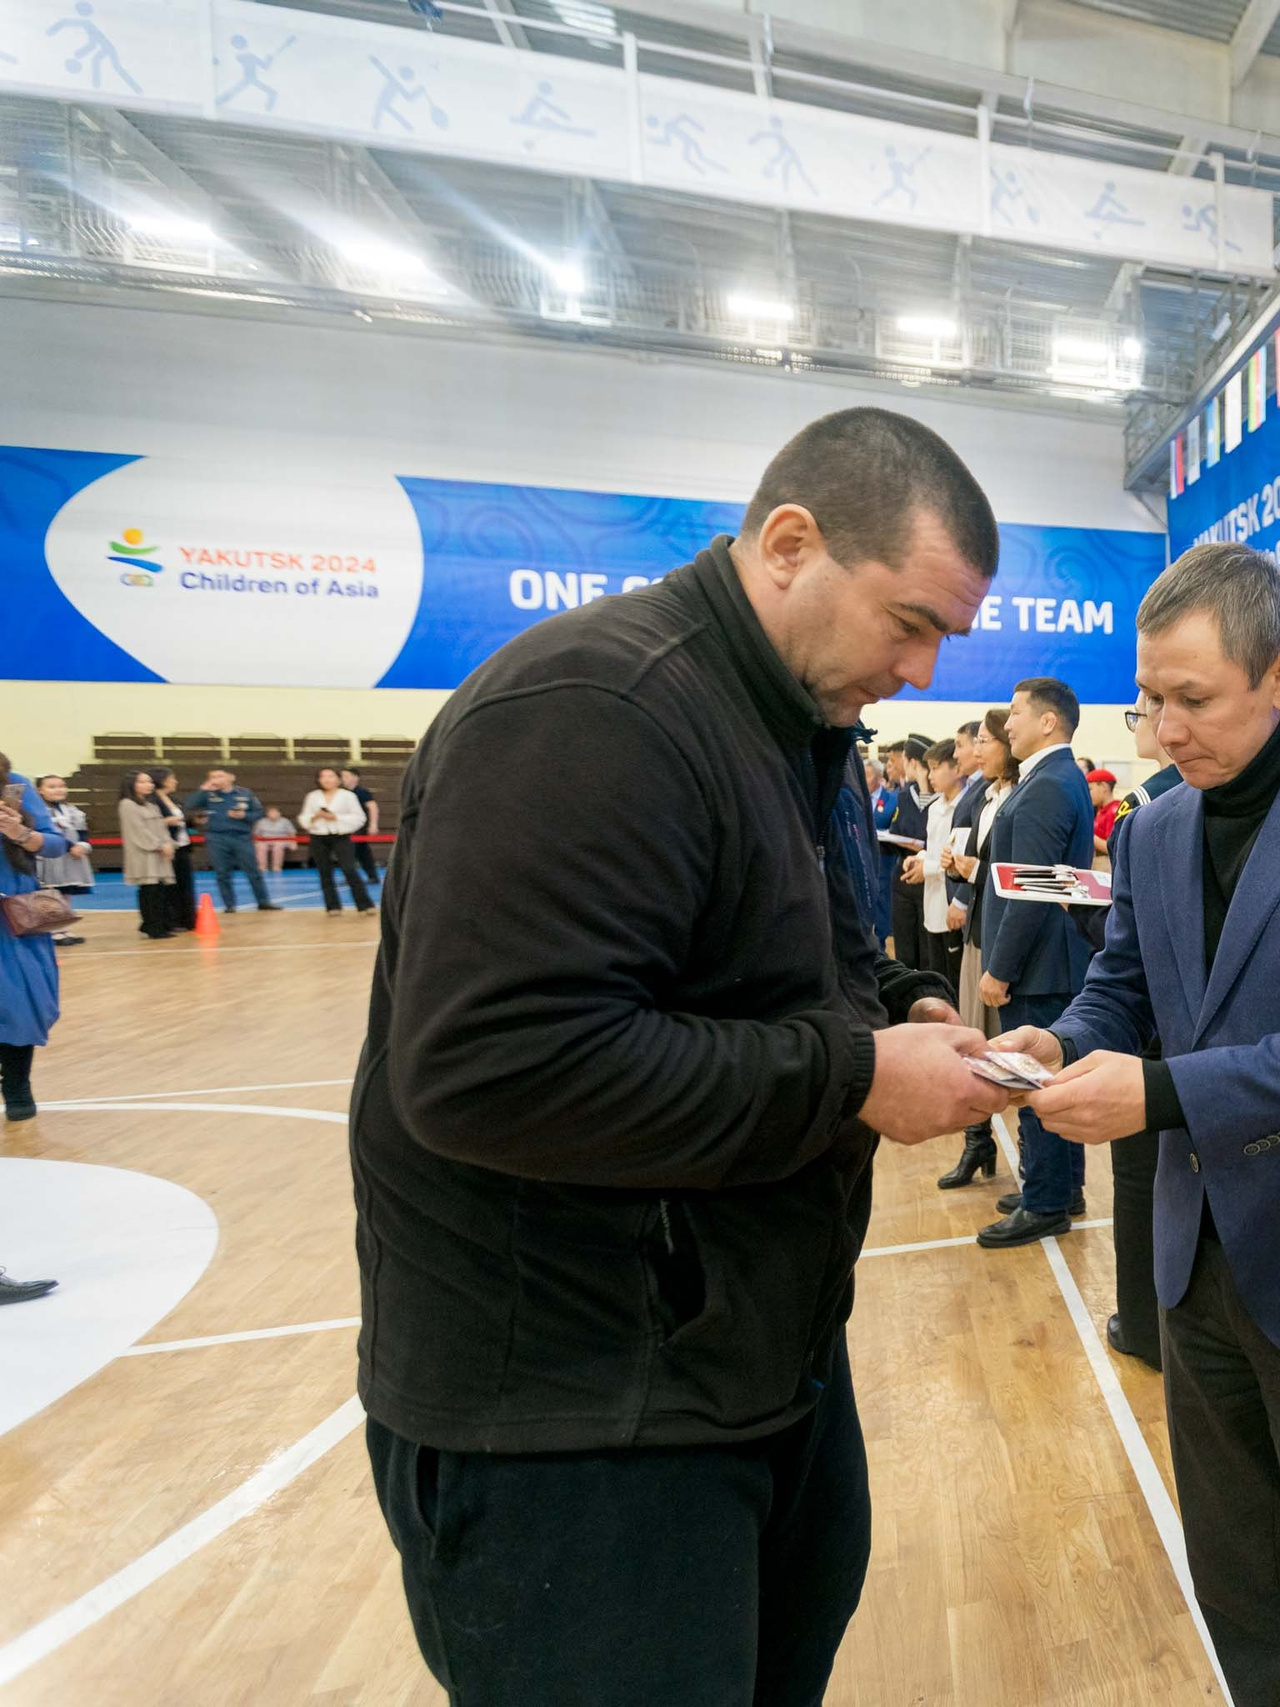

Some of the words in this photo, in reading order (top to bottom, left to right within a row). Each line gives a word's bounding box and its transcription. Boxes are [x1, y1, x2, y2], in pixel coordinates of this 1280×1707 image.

[179, 546, 304, 571] YAKUTSK
[310, 553, 377, 574] 2024
[179, 571, 289, 594] Children
[295, 577, 320, 596] of
[326, 579, 379, 599] Asia
[1011, 596, 1114, 635] TEAM
